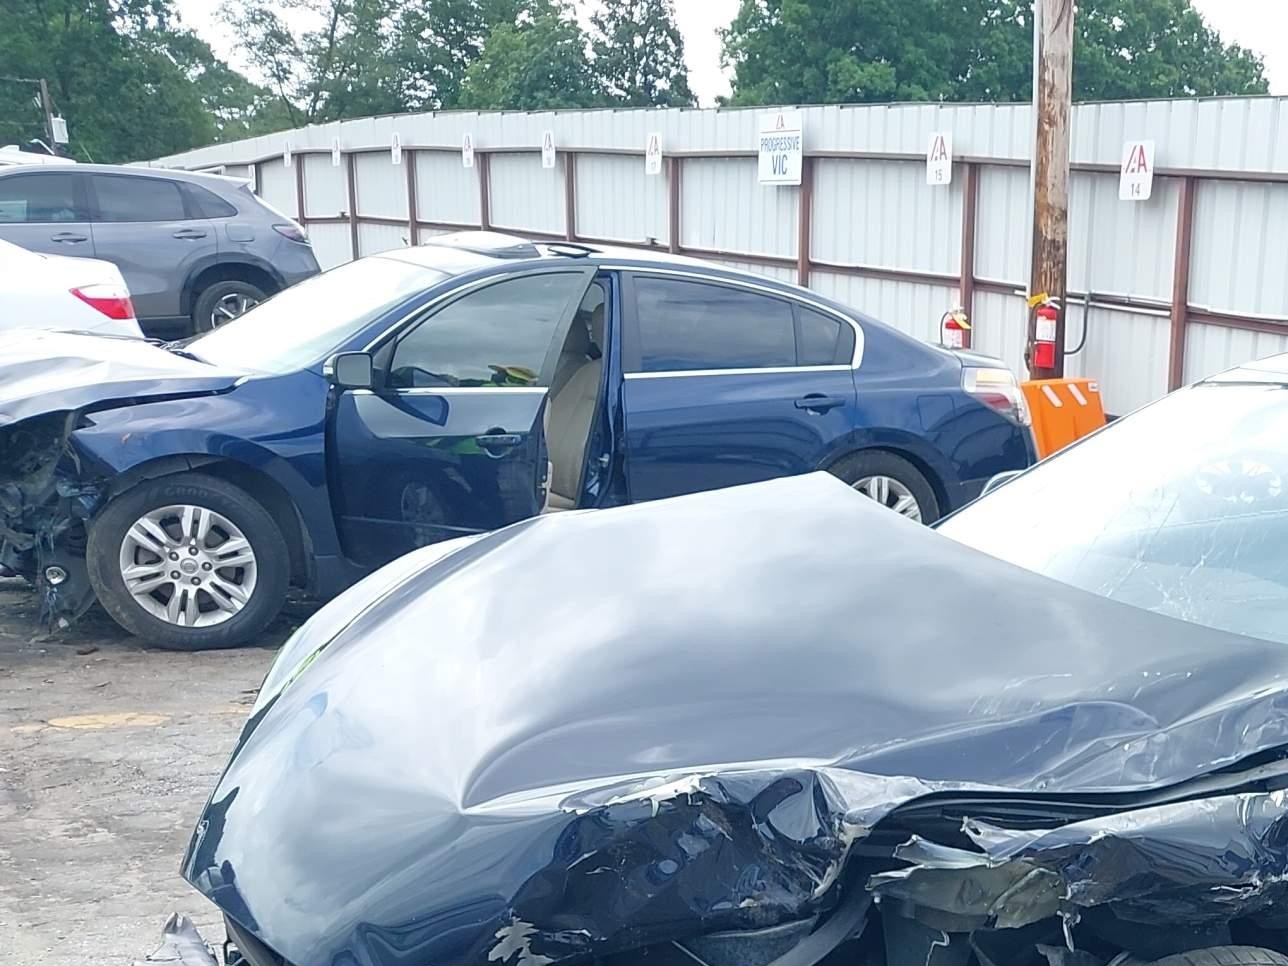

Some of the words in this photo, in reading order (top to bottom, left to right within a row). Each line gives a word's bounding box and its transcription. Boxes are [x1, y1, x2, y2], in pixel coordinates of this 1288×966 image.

[760, 136, 800, 152] PROGRESSIVE
[772, 154, 788, 175] VIC
[1130, 183, 1141, 197] 14
